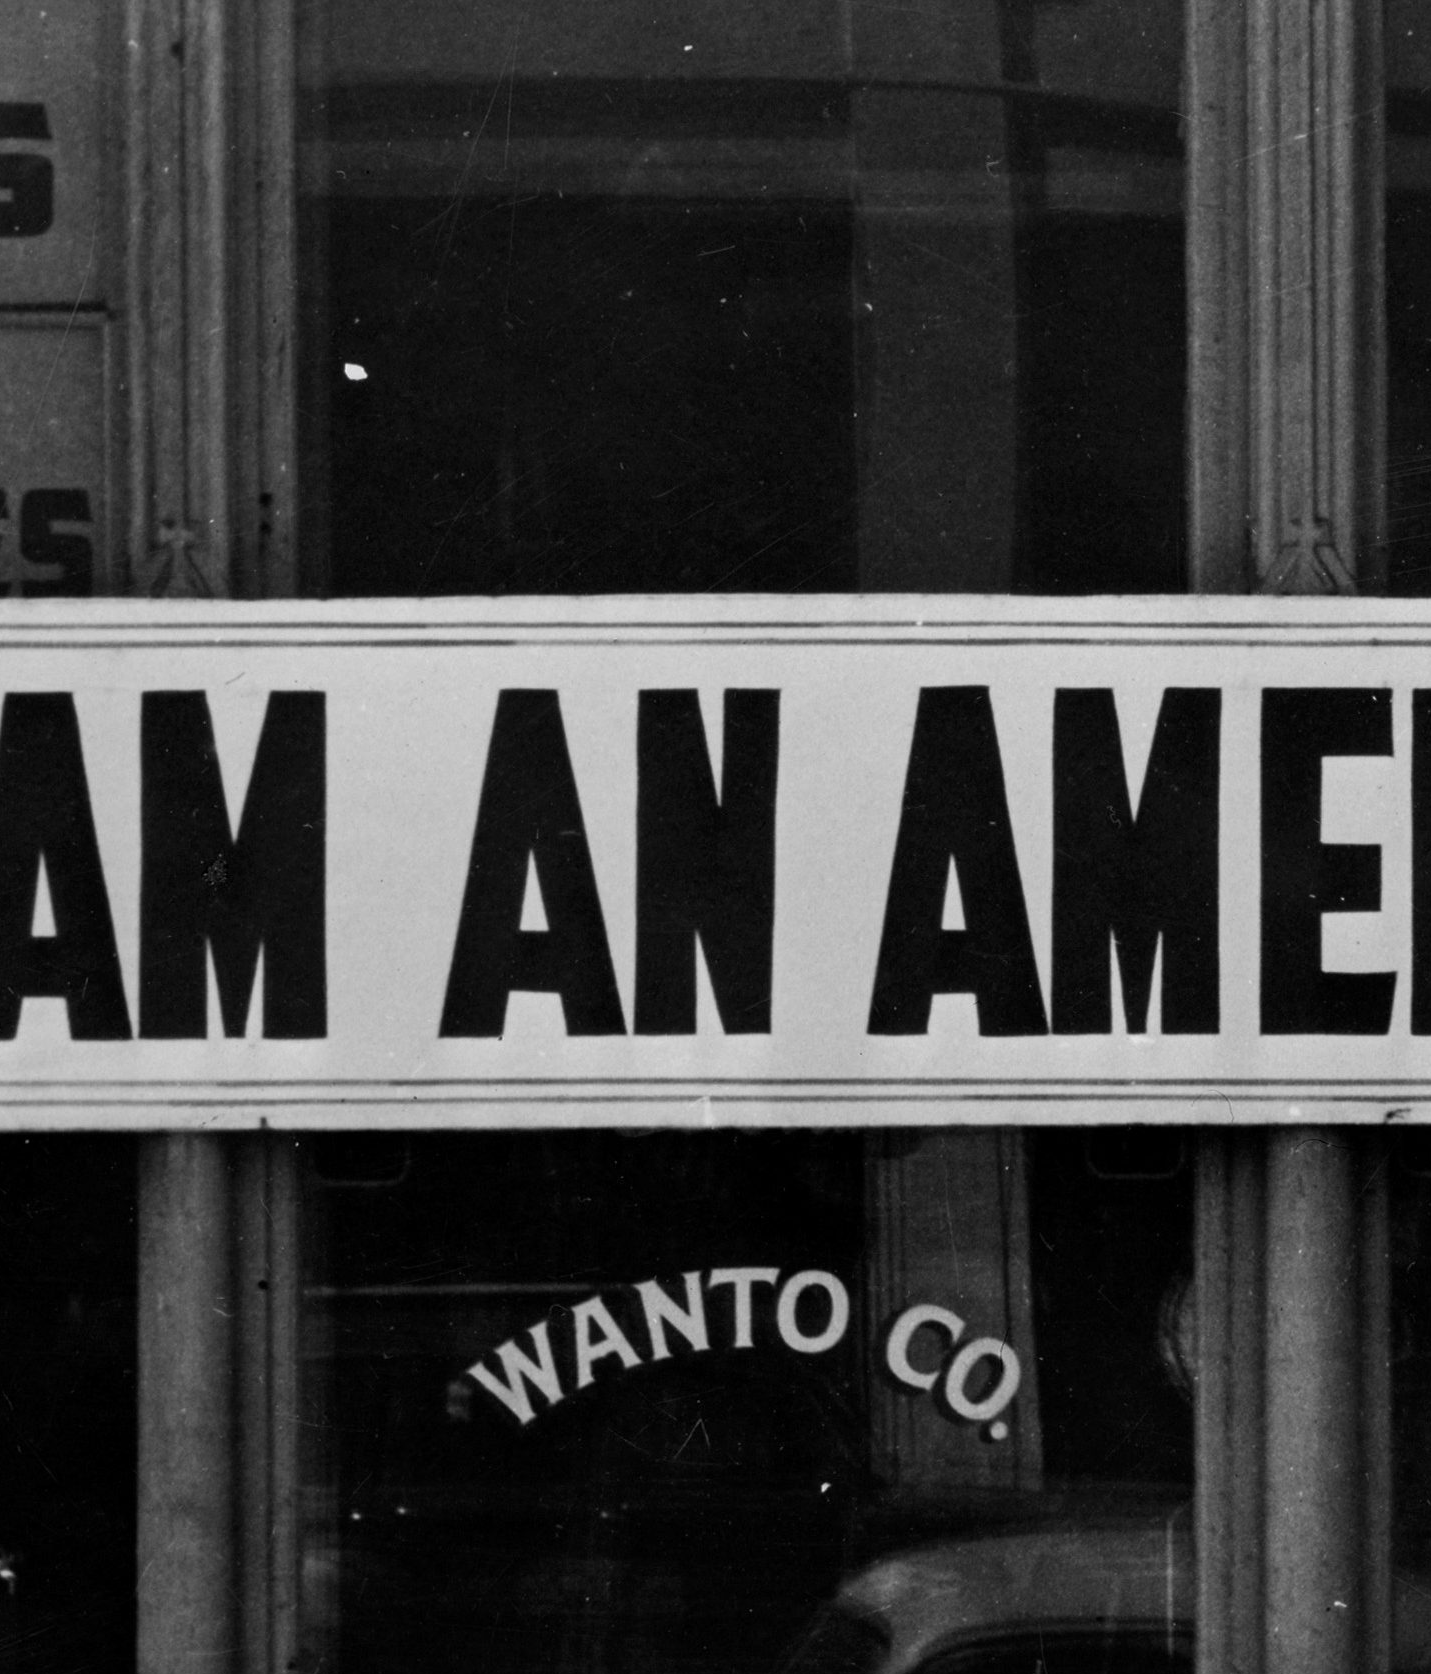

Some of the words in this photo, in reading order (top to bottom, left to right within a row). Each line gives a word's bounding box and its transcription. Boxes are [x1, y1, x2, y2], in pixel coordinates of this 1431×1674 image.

[438, 687, 780, 1039] AN
[469, 1266, 851, 1423] WANTO
[886, 1303, 1023, 1444] CO.
